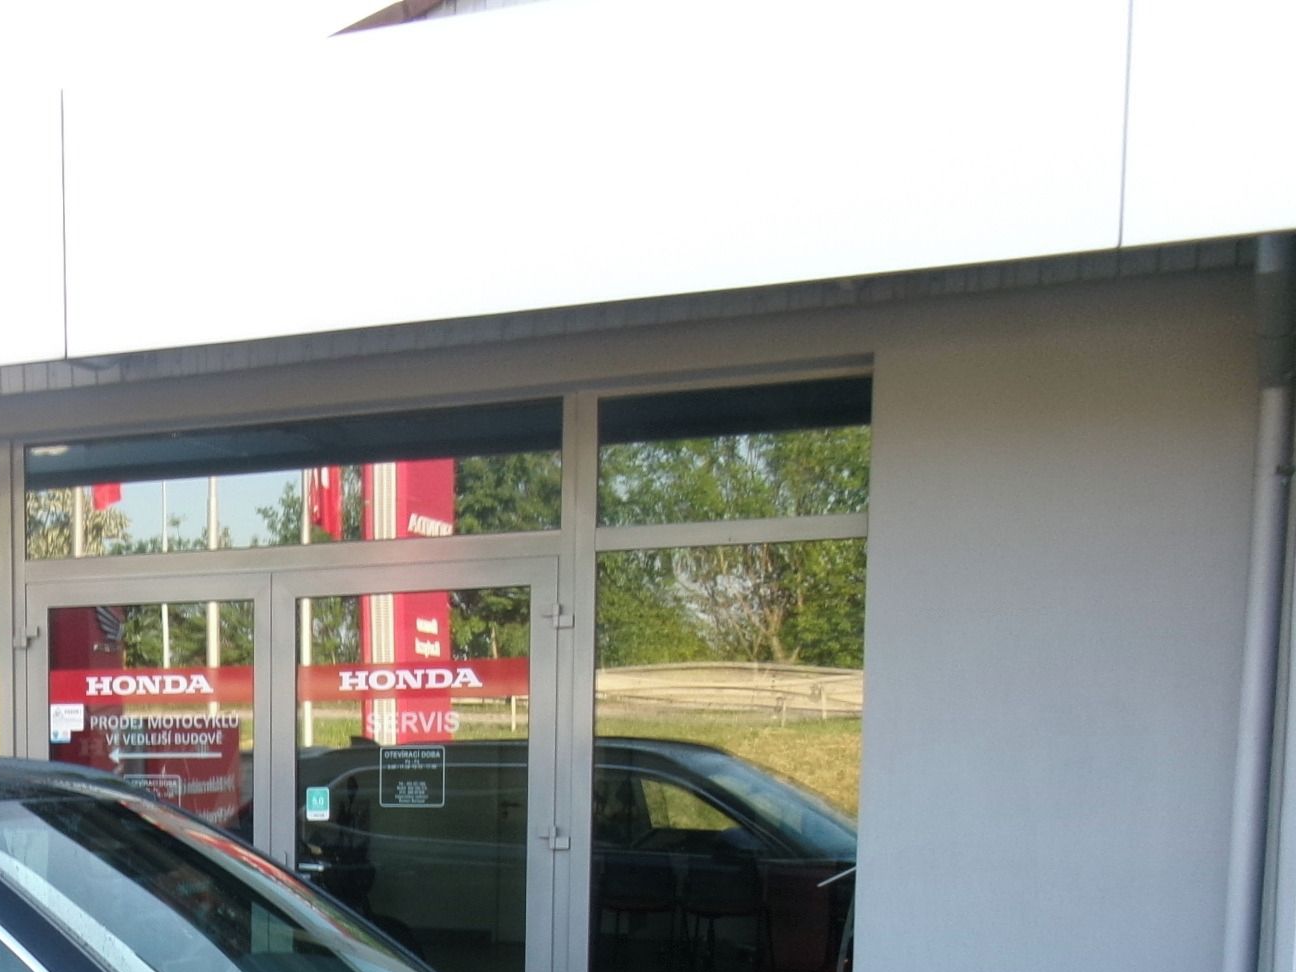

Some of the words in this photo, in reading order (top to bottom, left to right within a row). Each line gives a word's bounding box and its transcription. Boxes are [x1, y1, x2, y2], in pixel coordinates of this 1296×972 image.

[86, 674, 214, 696] HONDA
[339, 668, 482, 691] HONDA
[90, 715, 144, 730] PRODEJ
[147, 710, 239, 728] MOTOCYKLŮ
[366, 711, 460, 733] SERVIS
[106, 733, 120, 746] VE
[123, 731, 171, 745] VEDLEJŠÍ
[175, 730, 222, 744] BUDOVĚ
